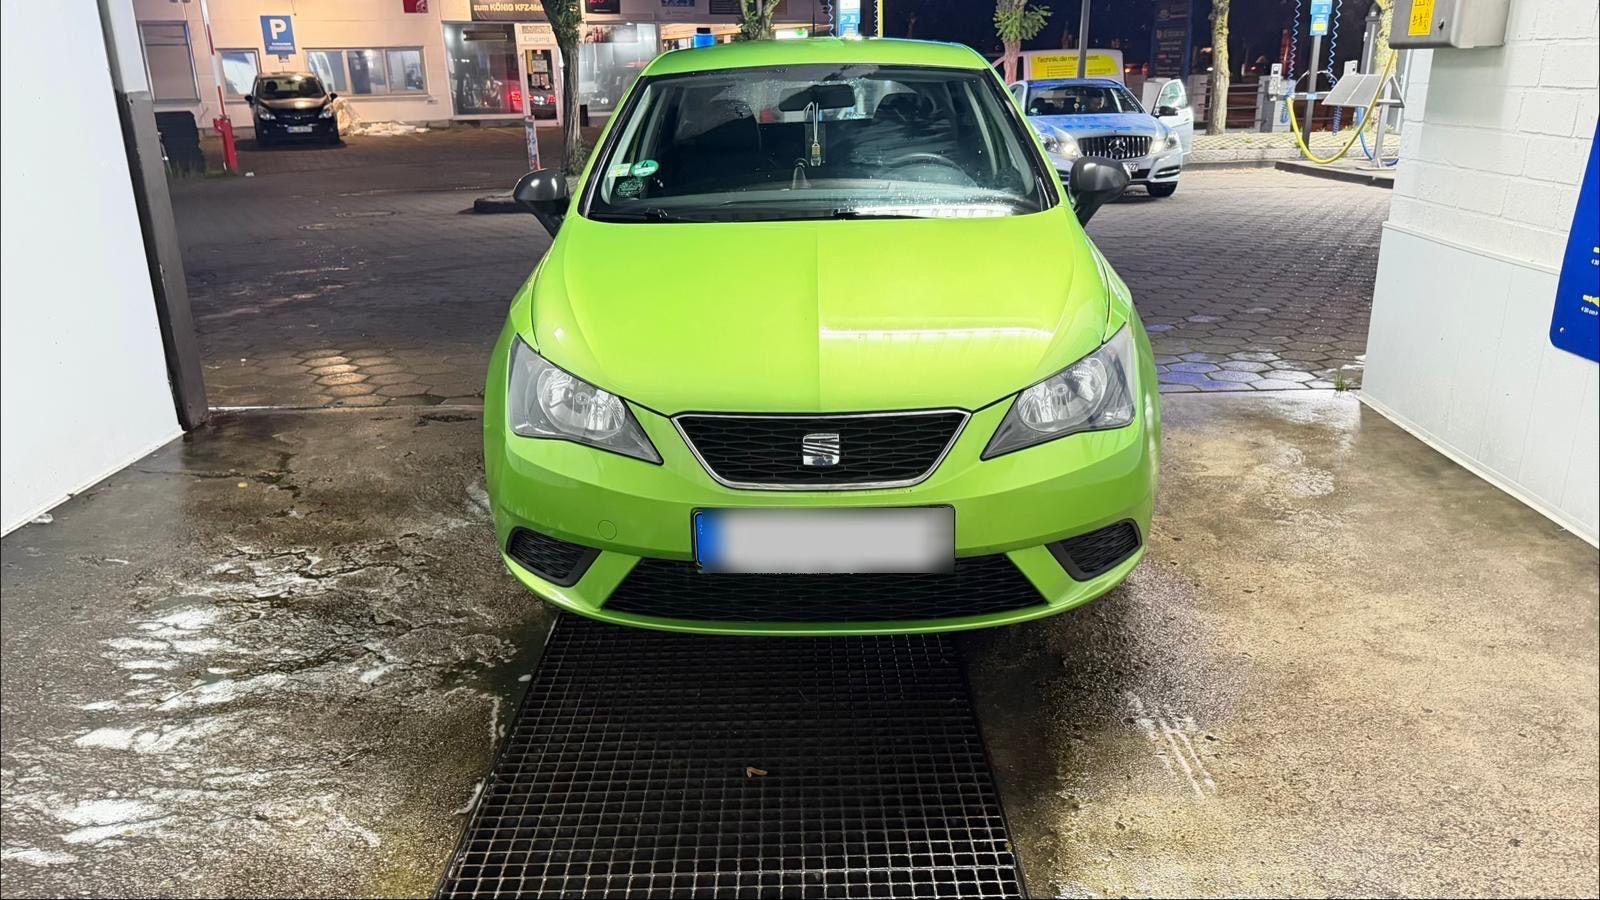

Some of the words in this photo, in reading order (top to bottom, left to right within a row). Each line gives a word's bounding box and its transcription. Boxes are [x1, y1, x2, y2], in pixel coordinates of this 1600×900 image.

[490, 3, 514, 12] KÖNIG
[270, 19, 287, 39] P
[524, 36, 550, 44] Eingang
